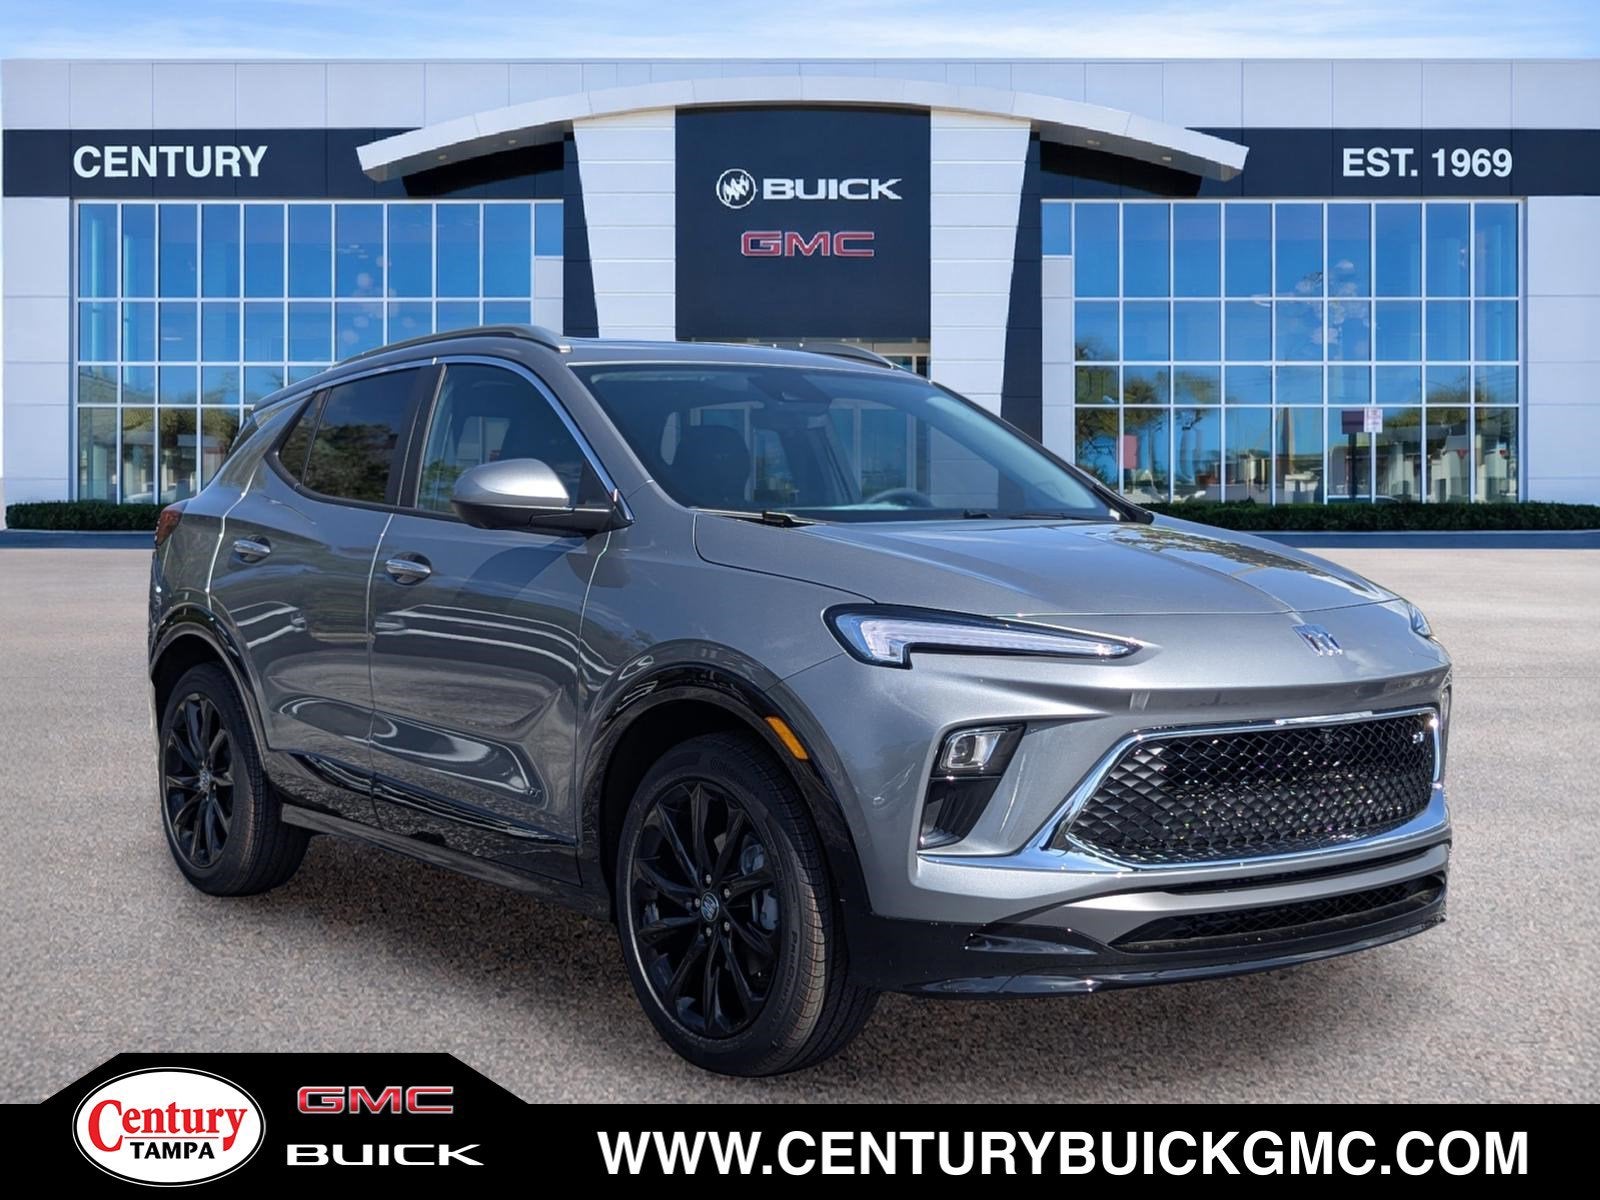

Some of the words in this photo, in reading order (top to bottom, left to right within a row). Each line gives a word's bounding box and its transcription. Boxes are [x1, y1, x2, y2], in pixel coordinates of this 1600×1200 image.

[73, 145, 268, 178] CENTURY
[1342, 147, 1418, 177] EST.
[1431, 148, 1513, 177] 1969
[763, 178, 903, 200] BUICK
[741, 230, 875, 257] GMC
